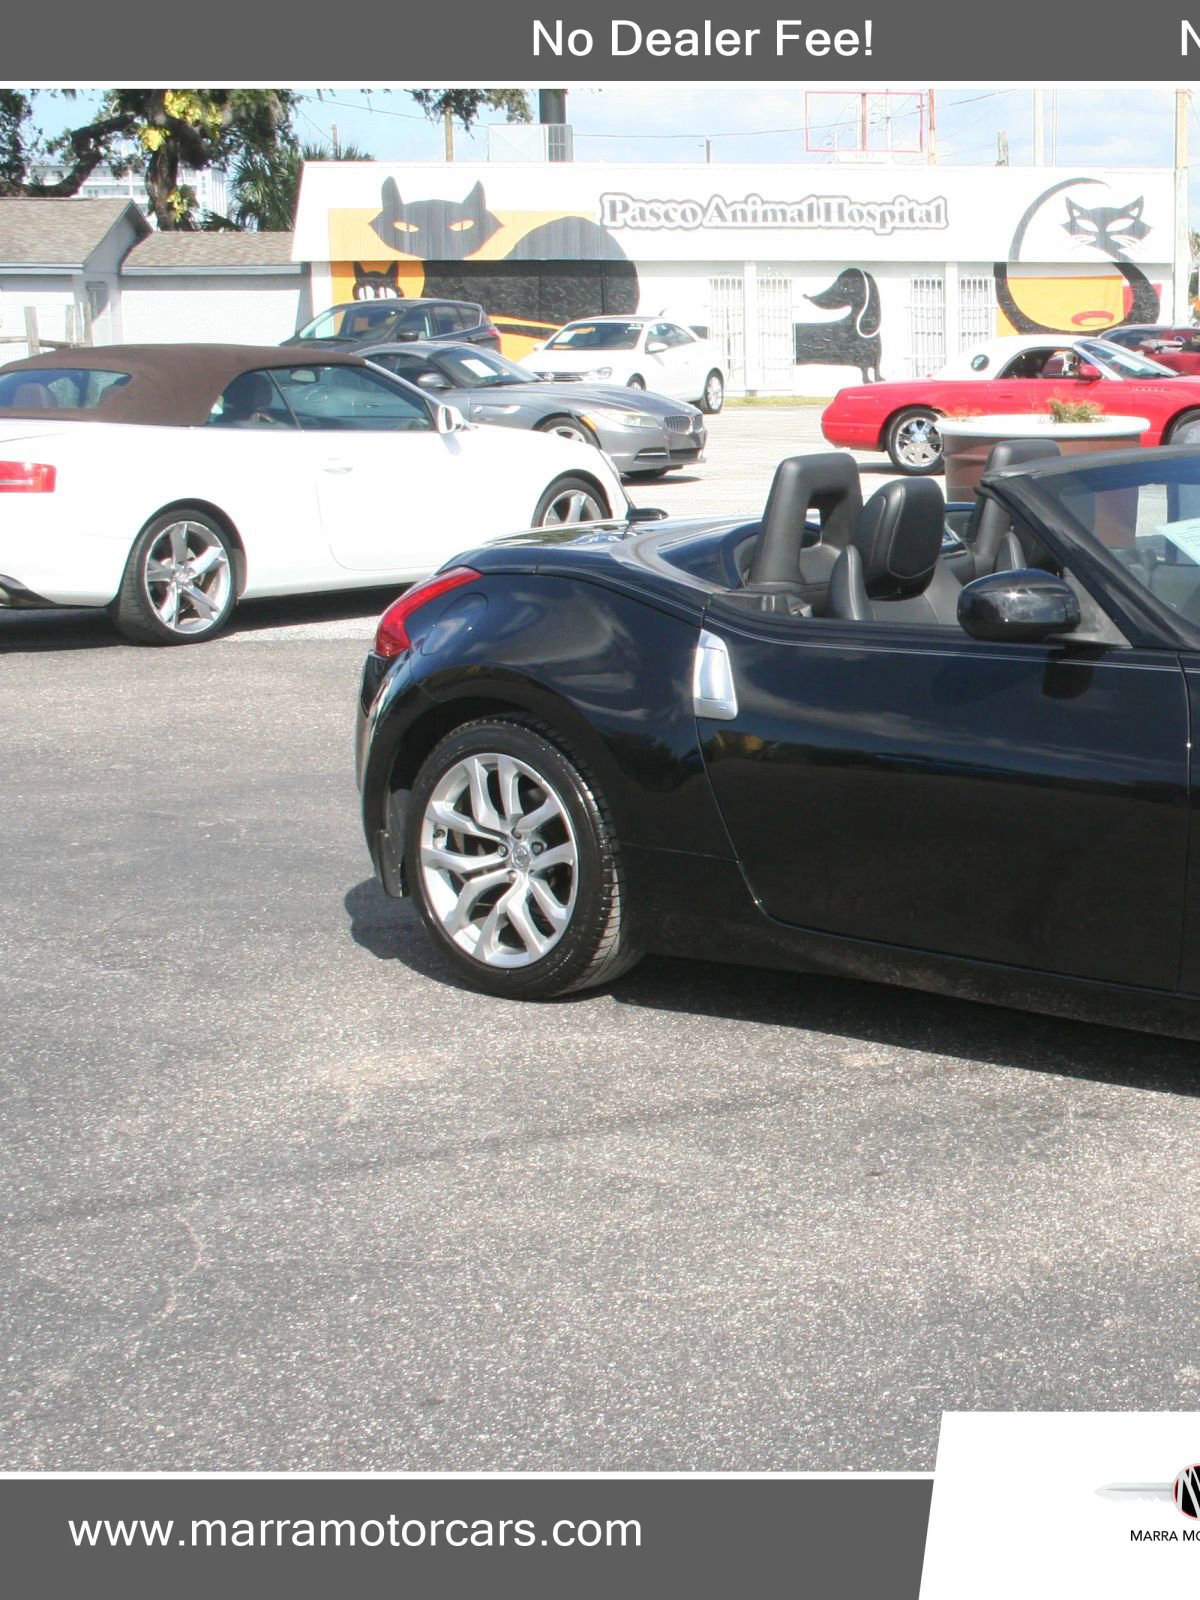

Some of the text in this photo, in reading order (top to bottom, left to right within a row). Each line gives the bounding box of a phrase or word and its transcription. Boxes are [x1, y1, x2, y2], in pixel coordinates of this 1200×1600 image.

[603, 196, 945, 232] Pasco Animal Hospital
